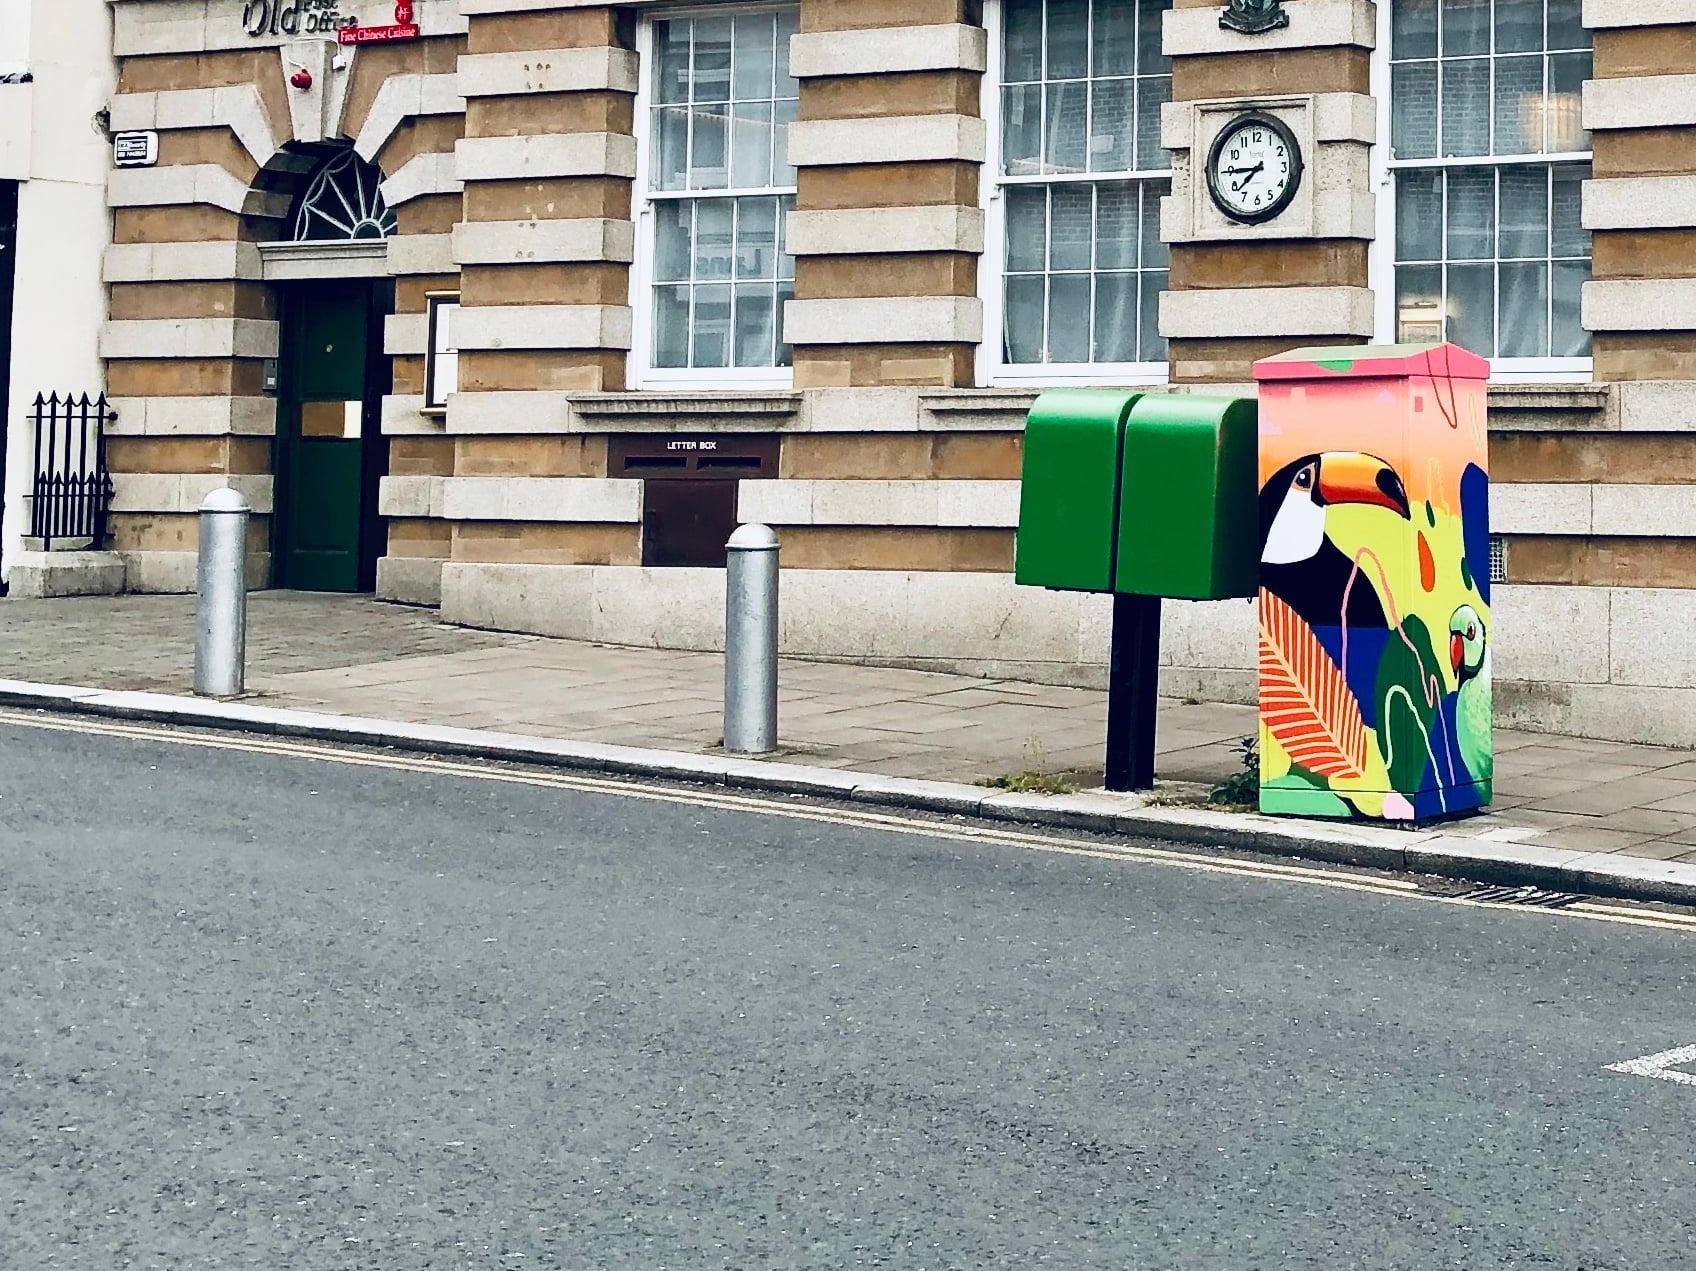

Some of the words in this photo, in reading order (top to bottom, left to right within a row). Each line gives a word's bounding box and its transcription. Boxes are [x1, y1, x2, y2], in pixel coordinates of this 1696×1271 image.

[340, 30, 357, 42] Fine
[357, 27, 387, 41] Chinese
[387, 26, 417, 39] Cuisine
[1240, 136, 1248, 148] 11
[1252, 131, 1262, 143] 12
[1230, 149, 1240, 161] 10
[1276, 145, 1284, 157] 2
[1227, 165, 1235, 176] 9
[1280, 161, 1287, 173] 3
[1231, 180, 1239, 192] 8
[1276, 178, 1284, 188] 4
[1241, 191, 1248, 202] 7
[1254, 194, 1261, 205] 6
[1267, 189, 1274, 200] 5
[667, 441, 697, 450] LETTER
[699, 441, 717, 450] BOX
